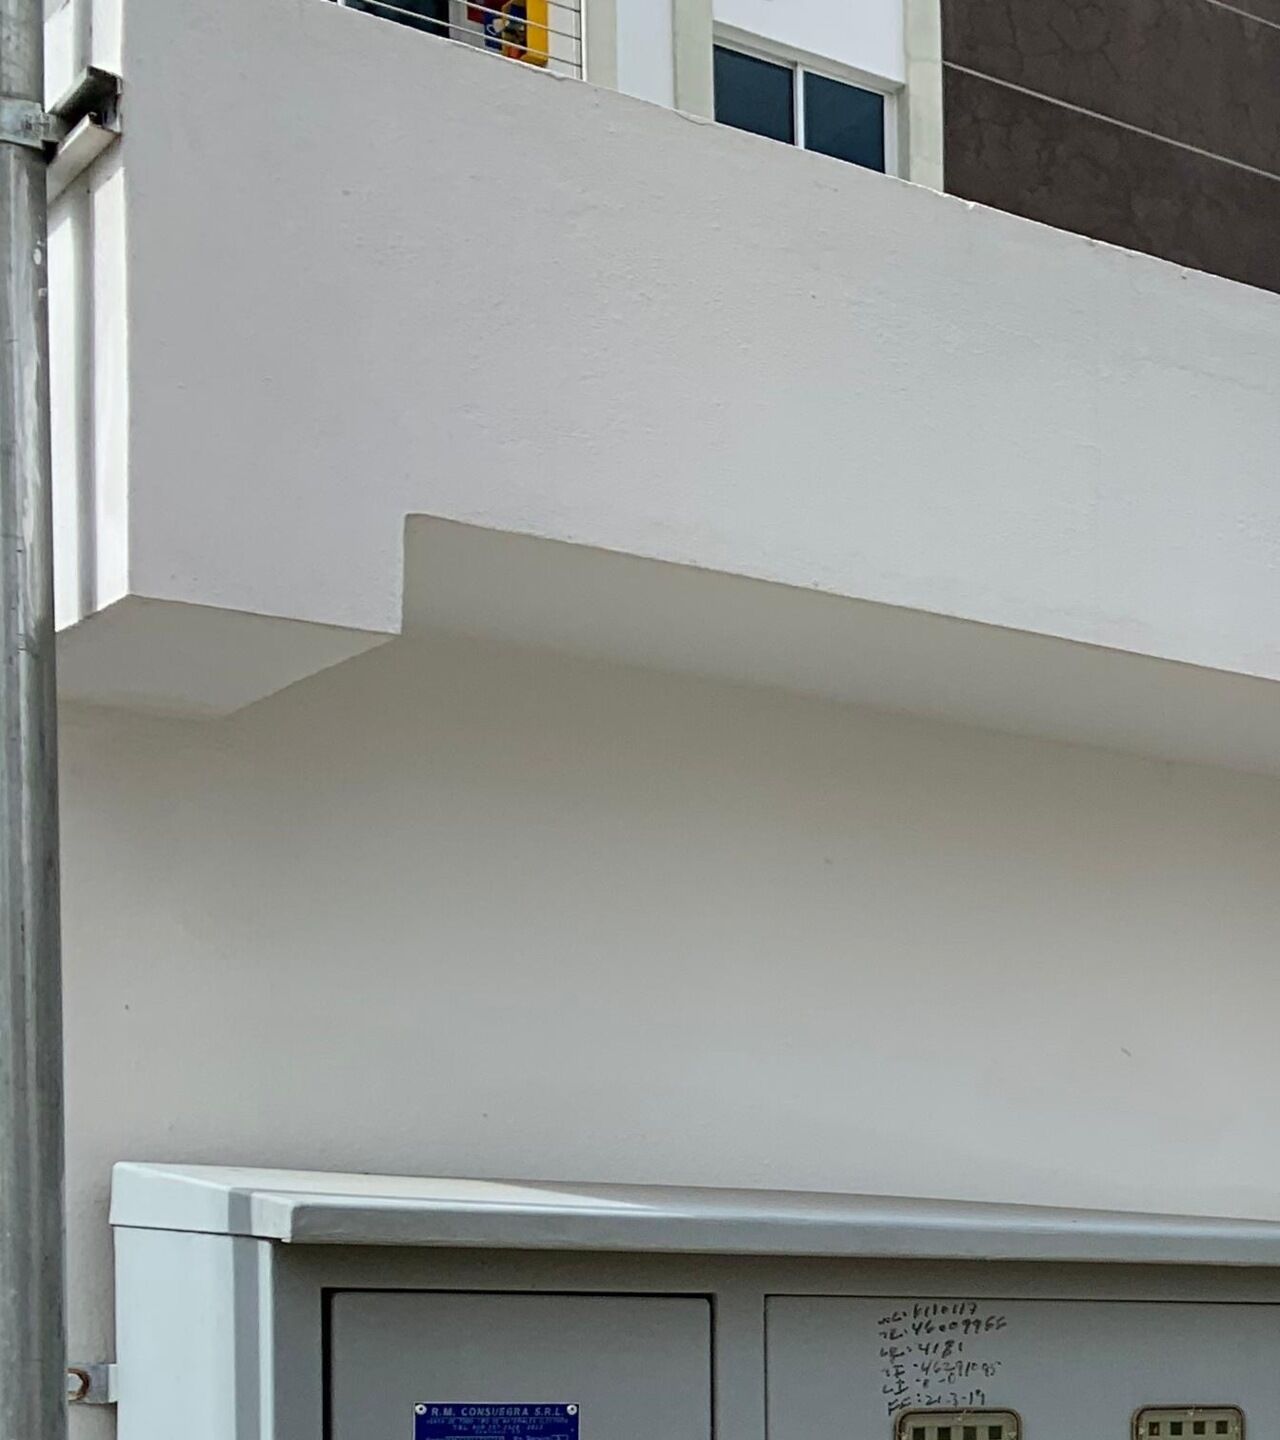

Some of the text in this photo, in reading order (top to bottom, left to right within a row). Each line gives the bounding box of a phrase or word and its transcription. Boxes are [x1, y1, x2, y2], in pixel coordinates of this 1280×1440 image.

[431, 1406, 565, 1417] R.M. CONSUEGRA S.R.L.
